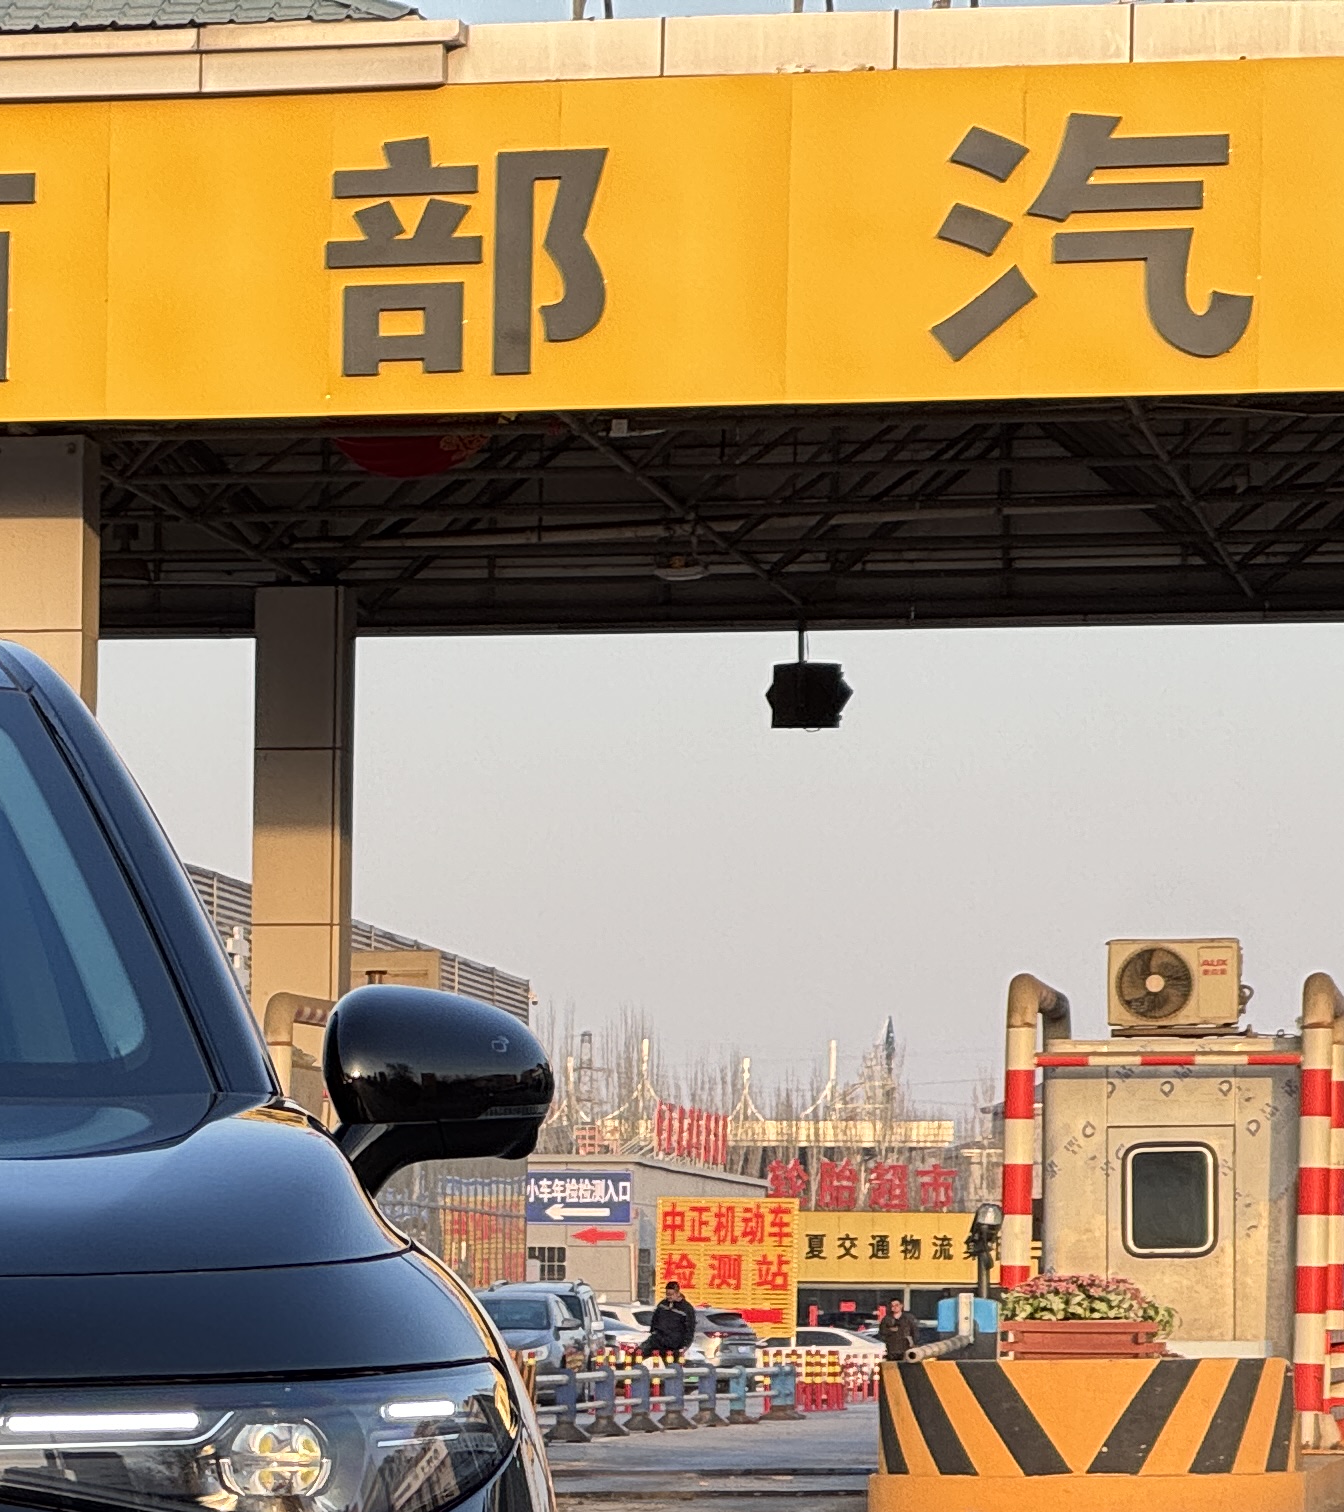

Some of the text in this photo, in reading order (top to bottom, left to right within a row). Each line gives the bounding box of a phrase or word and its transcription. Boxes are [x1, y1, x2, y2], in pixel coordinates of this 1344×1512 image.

[526, 1177, 631, 1203] 小车年检检测入口
[767, 1157, 957, 1211] 轮胎超市
[662, 1202, 793, 1247] 中正机动车
[805, 1233, 1001, 1261] 夏交通物流
[663, 1252, 792, 1291] 检测站
